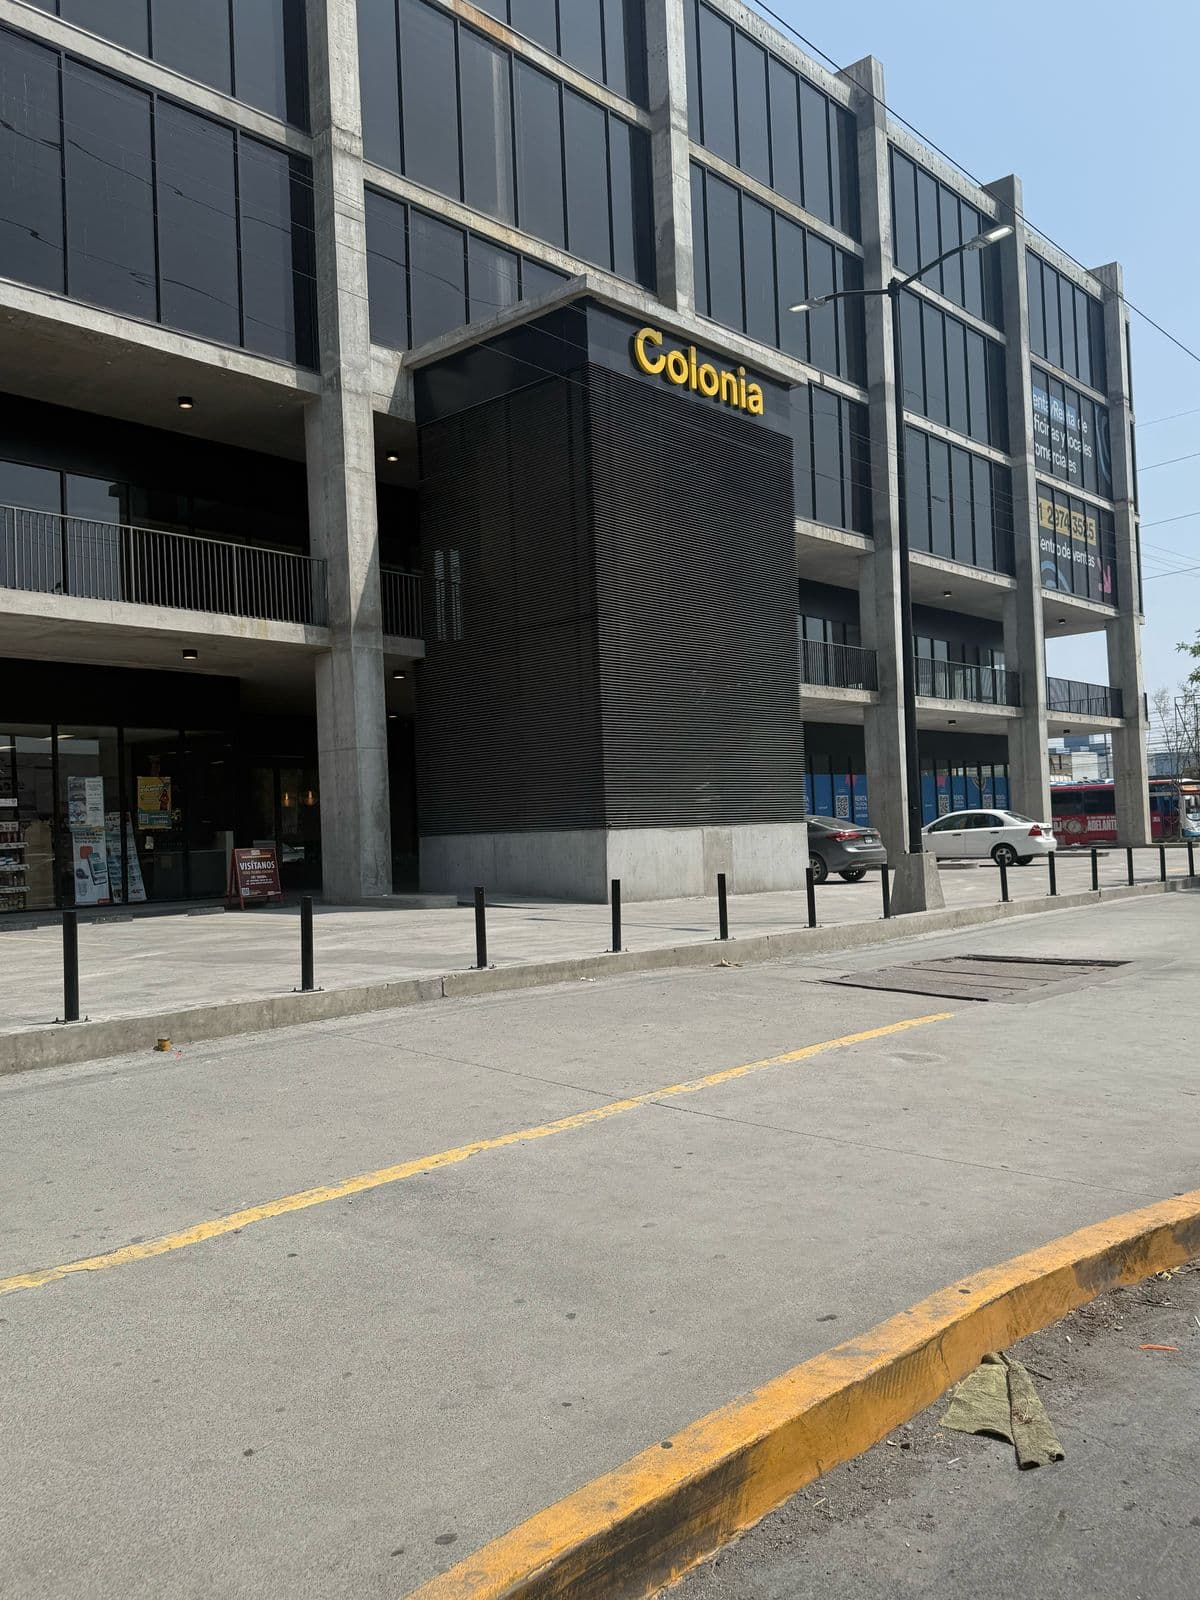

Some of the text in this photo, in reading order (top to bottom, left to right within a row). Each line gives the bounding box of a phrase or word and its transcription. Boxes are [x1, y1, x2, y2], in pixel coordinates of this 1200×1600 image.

[634, 327, 764, 415] Colonia
[1060, 431, 1066, 449] y
[1040, 538, 1062, 557] entro
[1062, 541, 1071, 560] de
